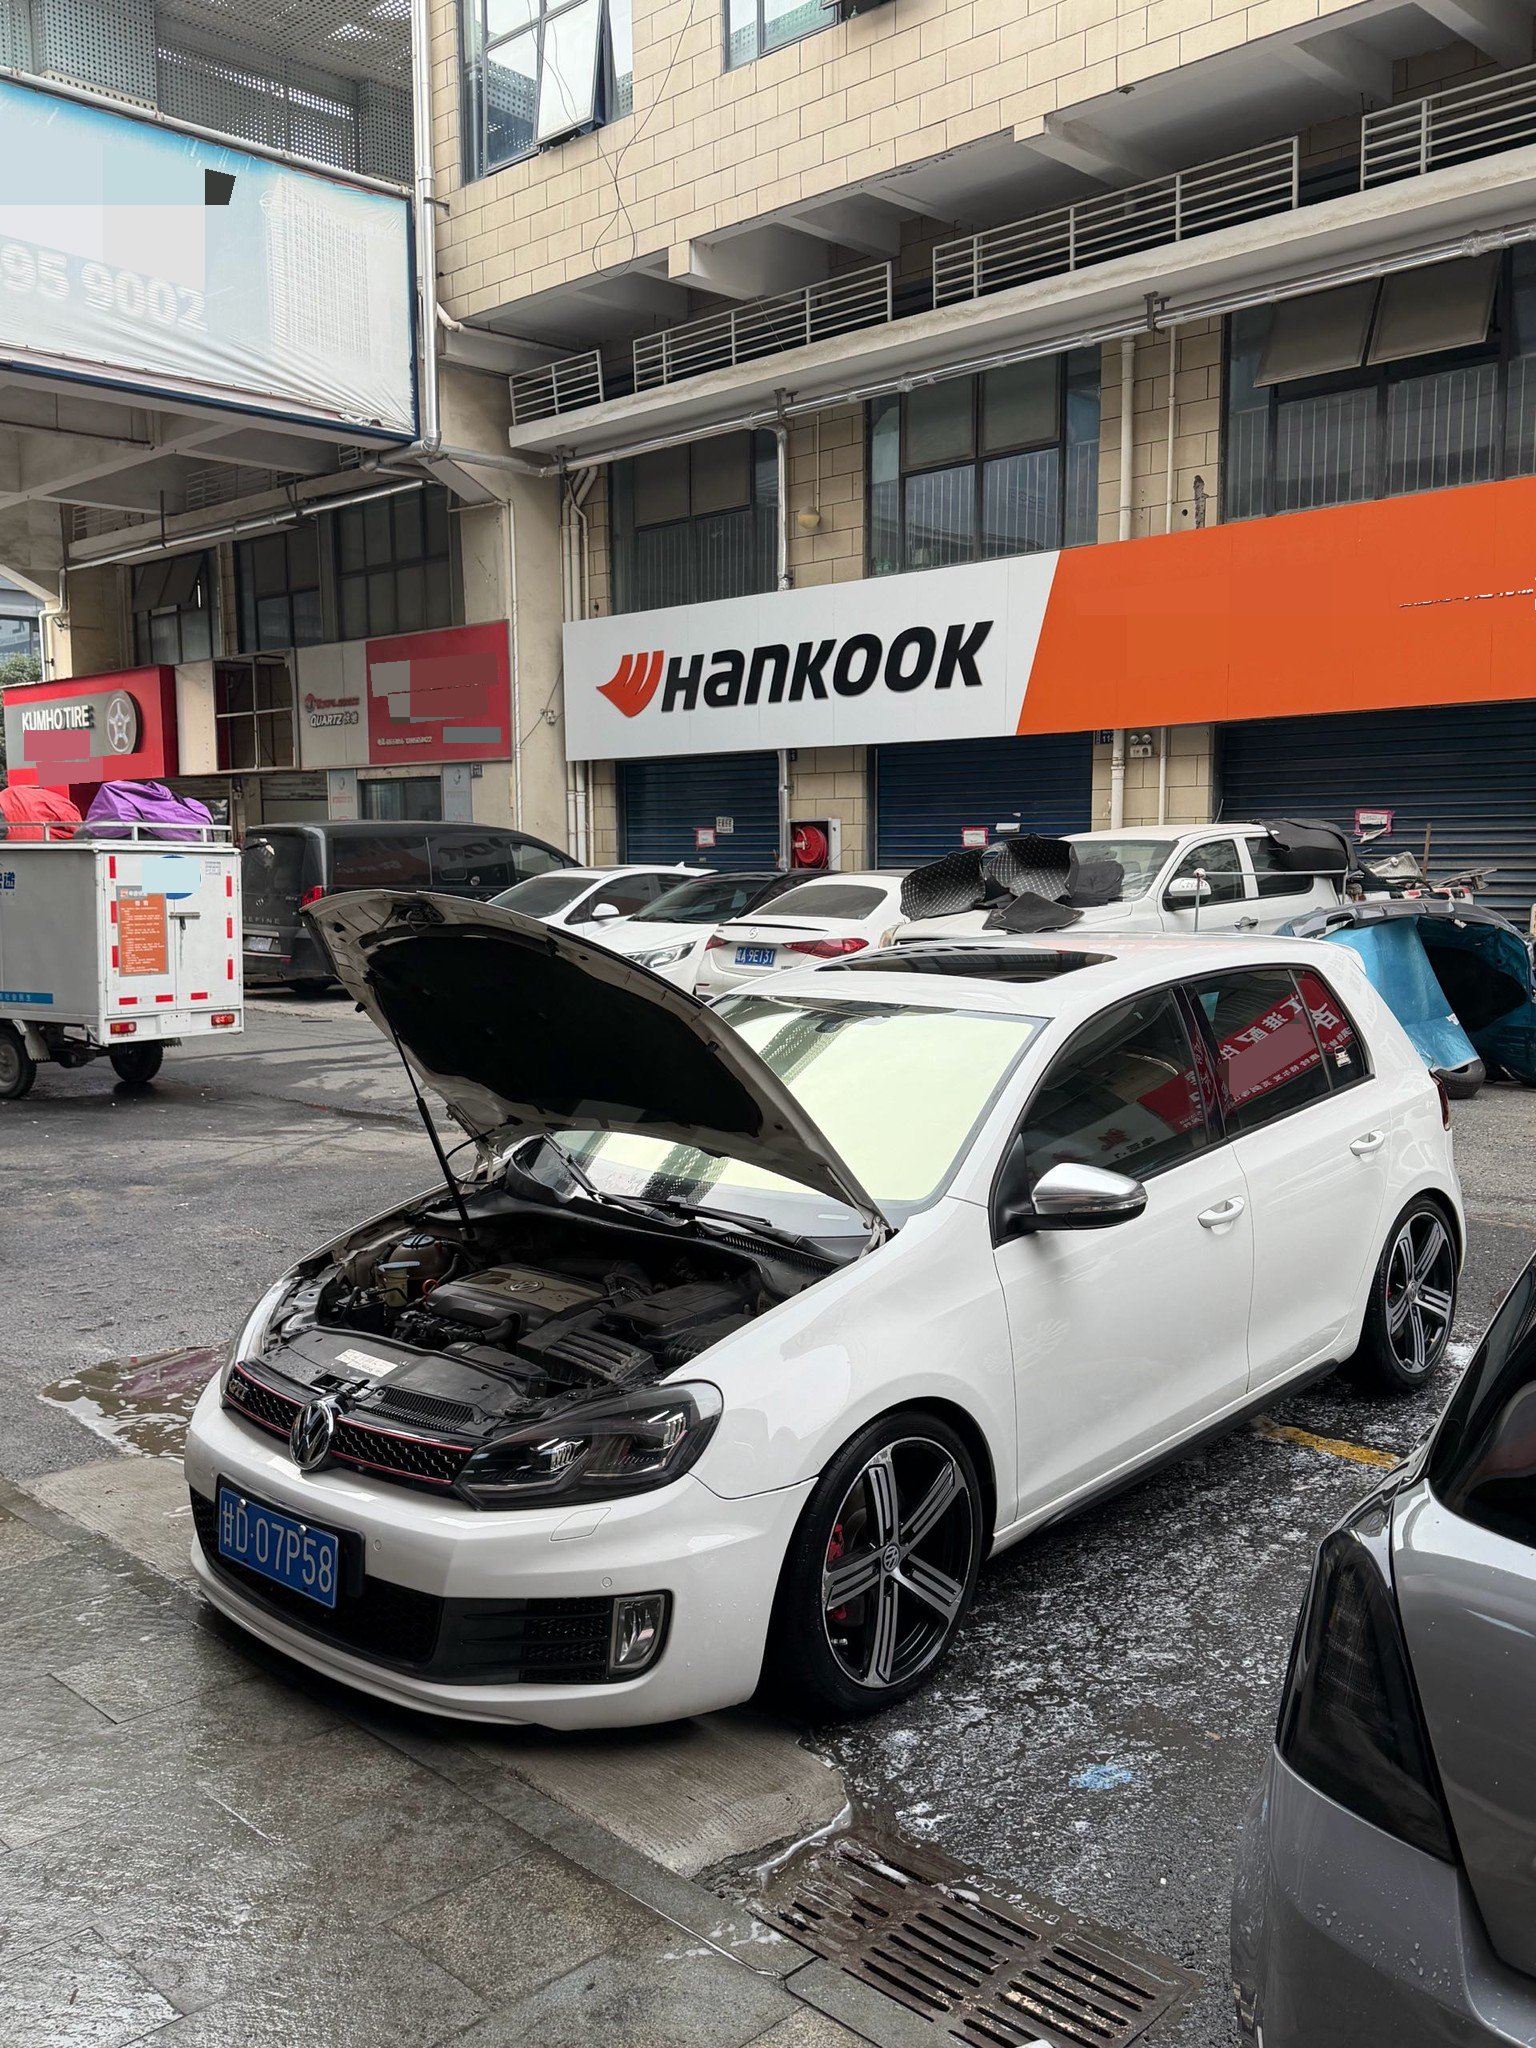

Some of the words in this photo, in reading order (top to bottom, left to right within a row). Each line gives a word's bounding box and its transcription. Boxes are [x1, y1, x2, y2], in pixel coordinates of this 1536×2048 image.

[22, 708, 62, 733] KUMHO
[63, 704, 91, 729] TIRE
[310, 713, 343, 728] QUARTZ
